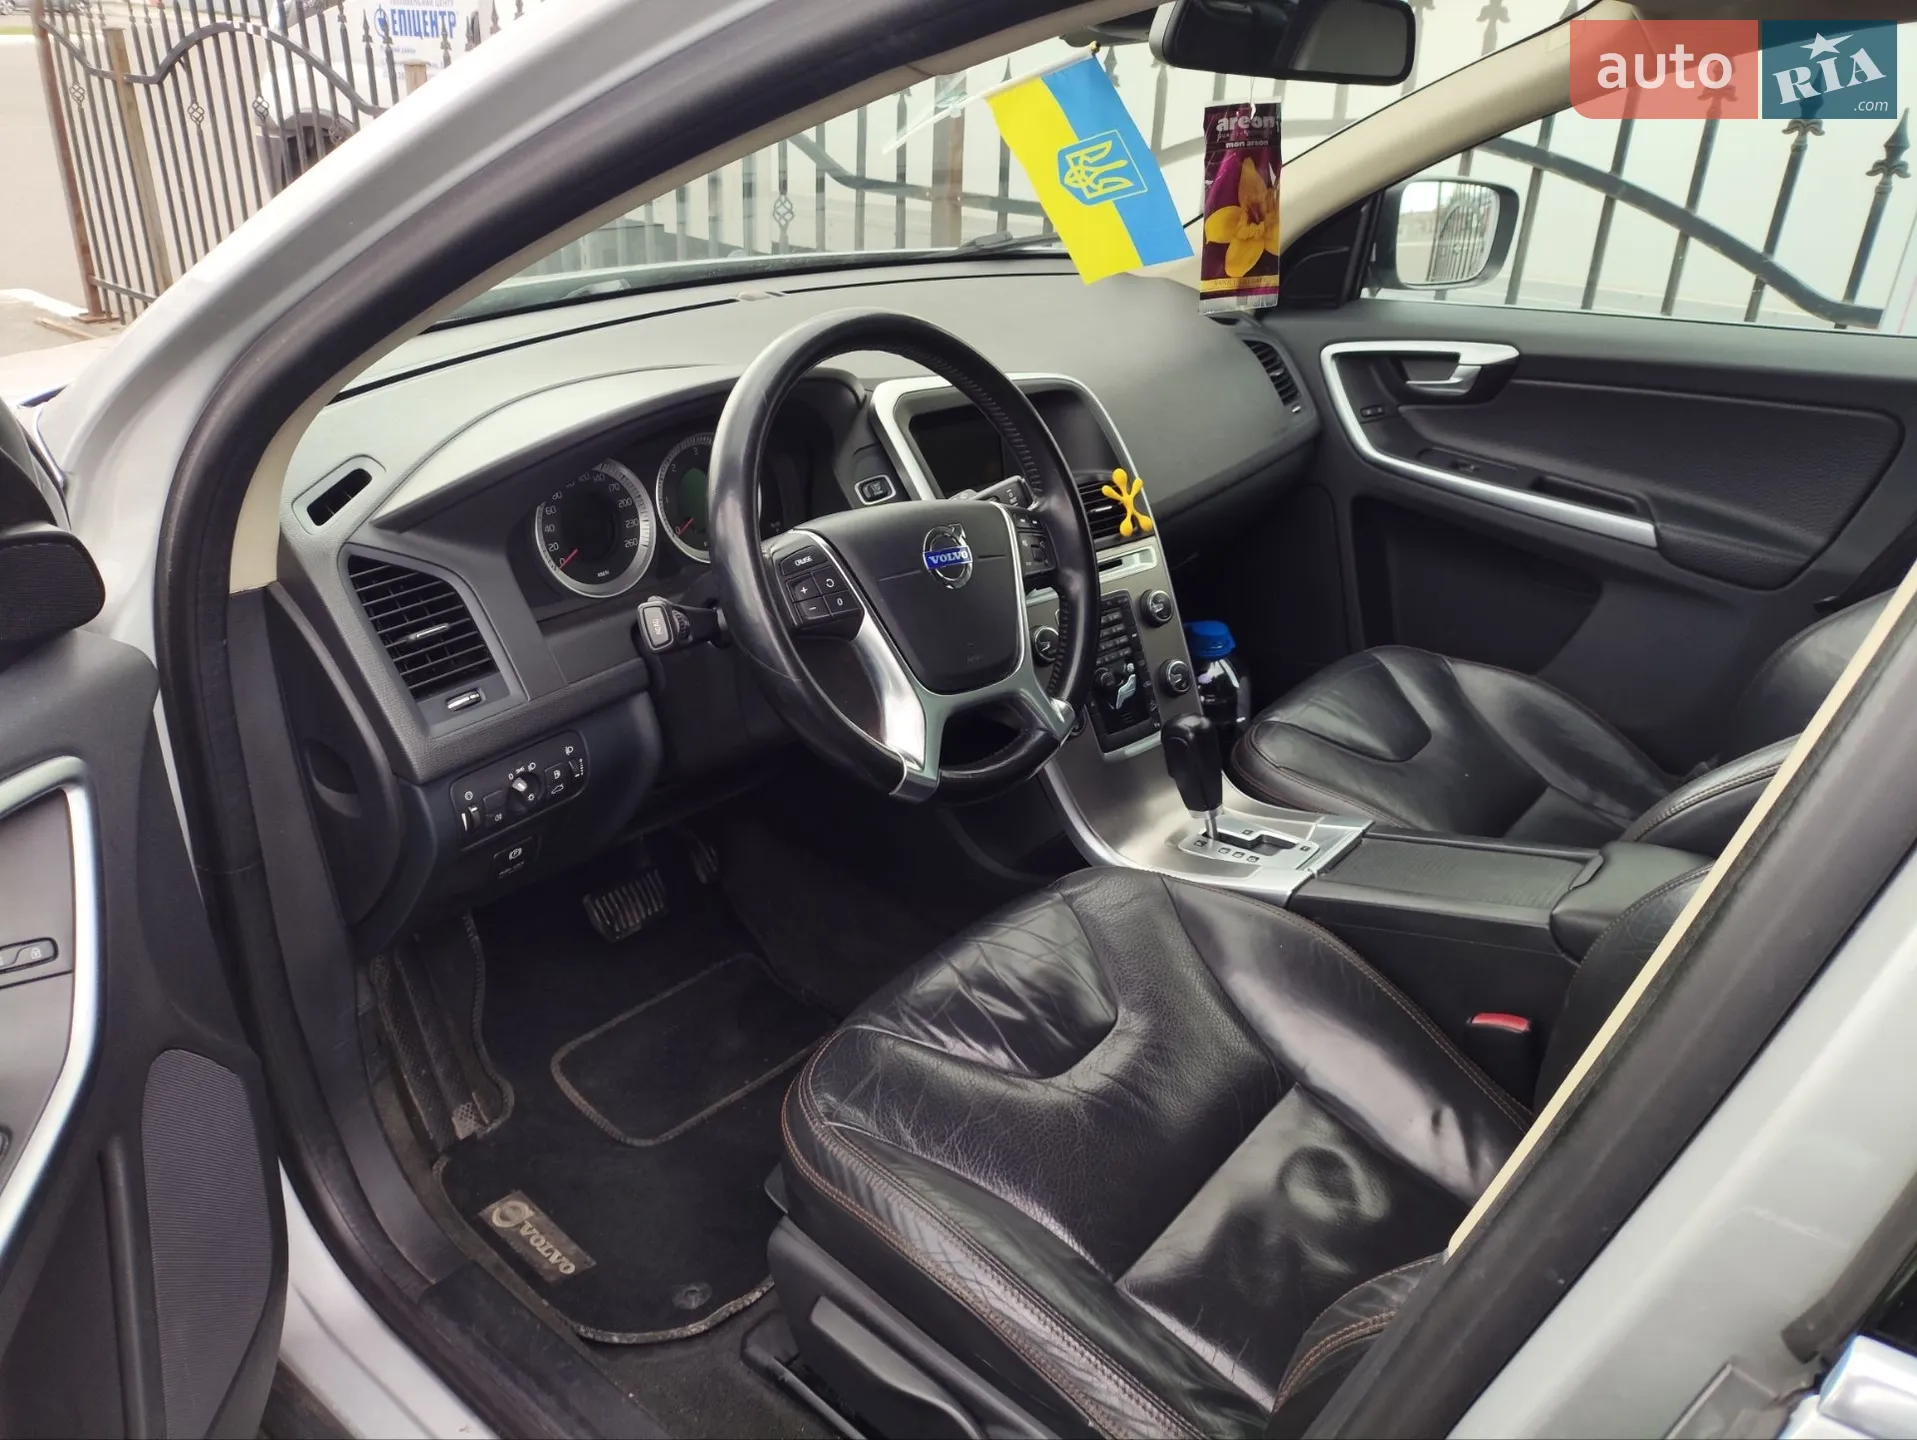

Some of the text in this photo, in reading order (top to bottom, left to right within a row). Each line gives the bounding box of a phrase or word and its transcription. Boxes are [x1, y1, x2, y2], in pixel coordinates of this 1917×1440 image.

[390, 9, 457, 39] ЕПІЦЕНТР
[1216, 115, 1275, 132] areon
[618, 497, 633, 508] 200
[625, 518, 639, 529] 230
[624, 538, 639, 549] 260
[928, 549, 970, 566] VOLVO
[519, 1219, 576, 1275] VOLVO
